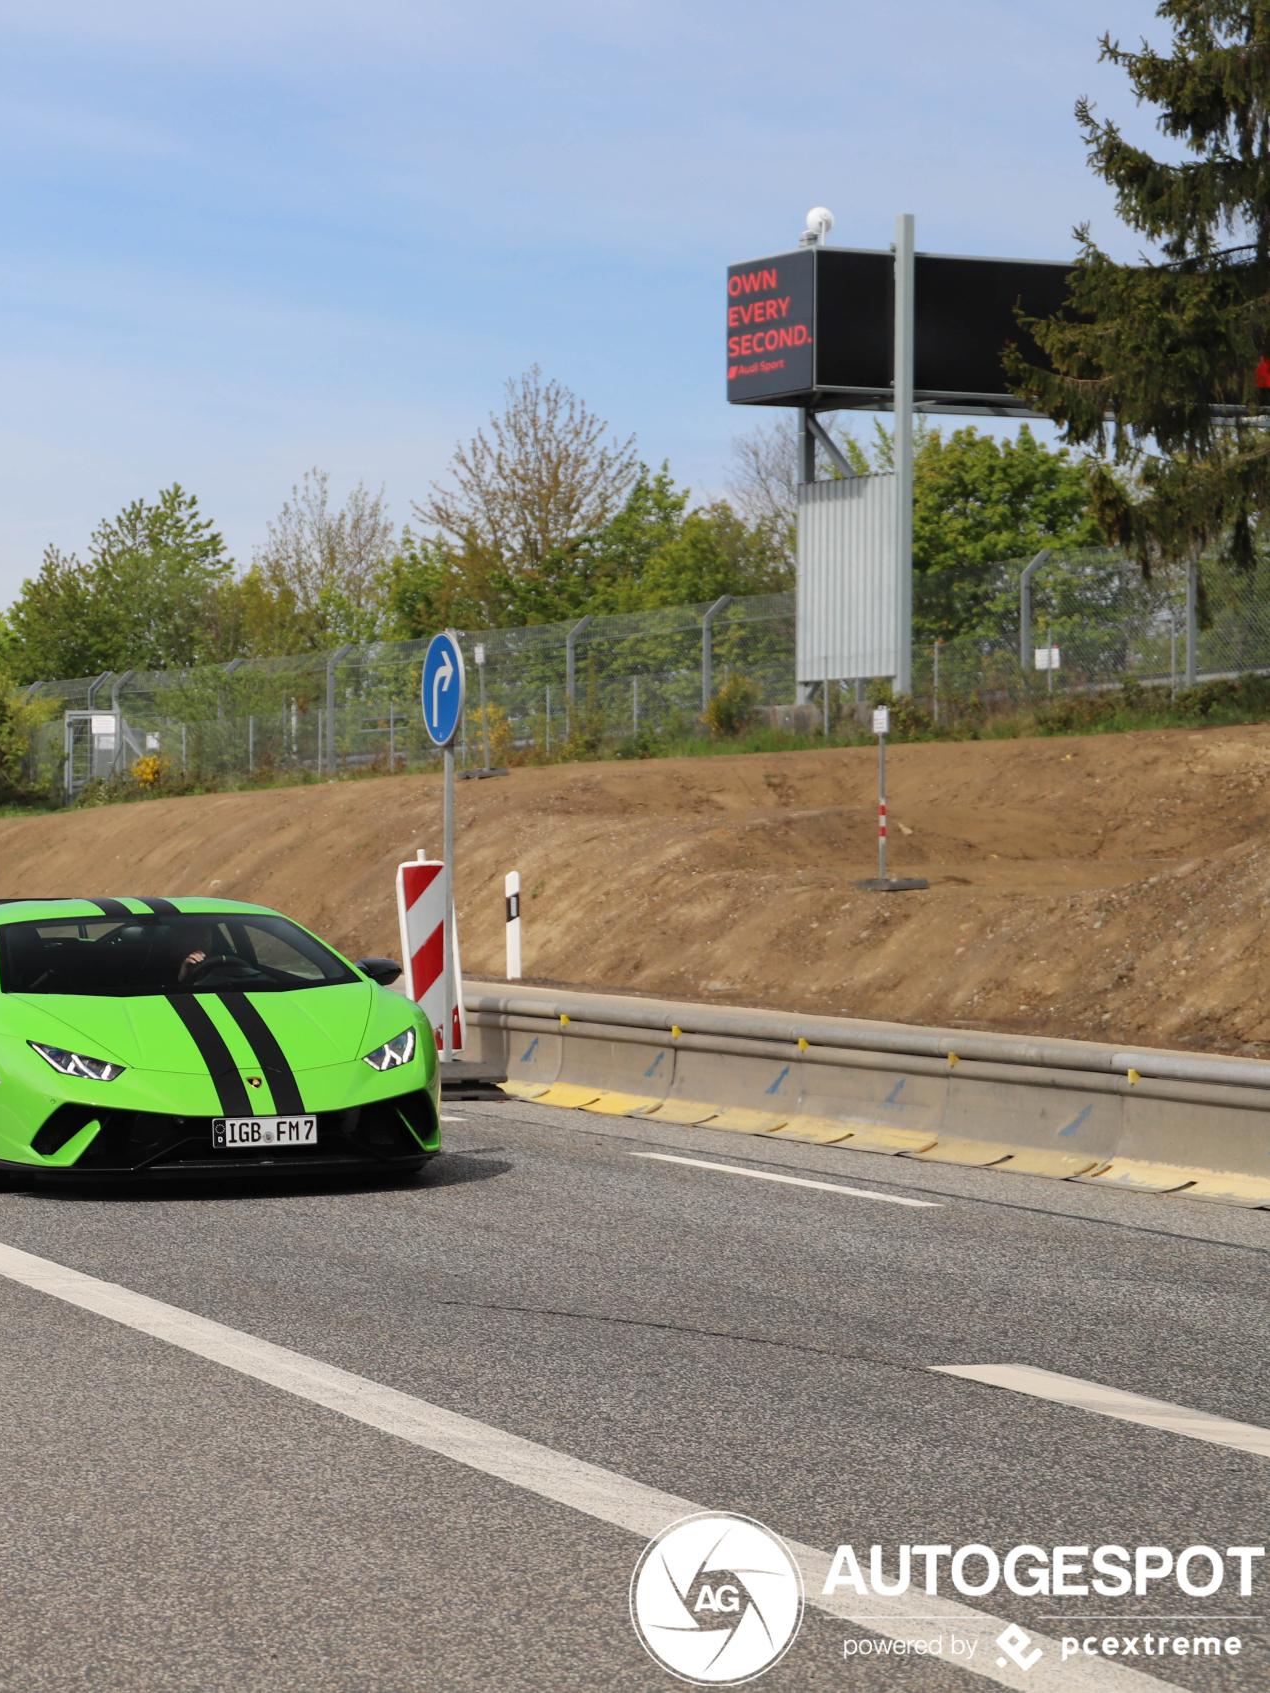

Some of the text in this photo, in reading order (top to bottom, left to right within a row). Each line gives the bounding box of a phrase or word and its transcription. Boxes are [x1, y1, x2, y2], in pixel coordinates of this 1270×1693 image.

[728, 268, 777, 296] OWN
[728, 297, 790, 327] EVERY
[728, 325, 813, 357] SECOND.
[738, 359, 785, 374] Audi Sport
[229, 1122, 262, 1144] IGB
[277, 1120, 300, 1141] FM
[304, 1120, 314, 1140] 7
